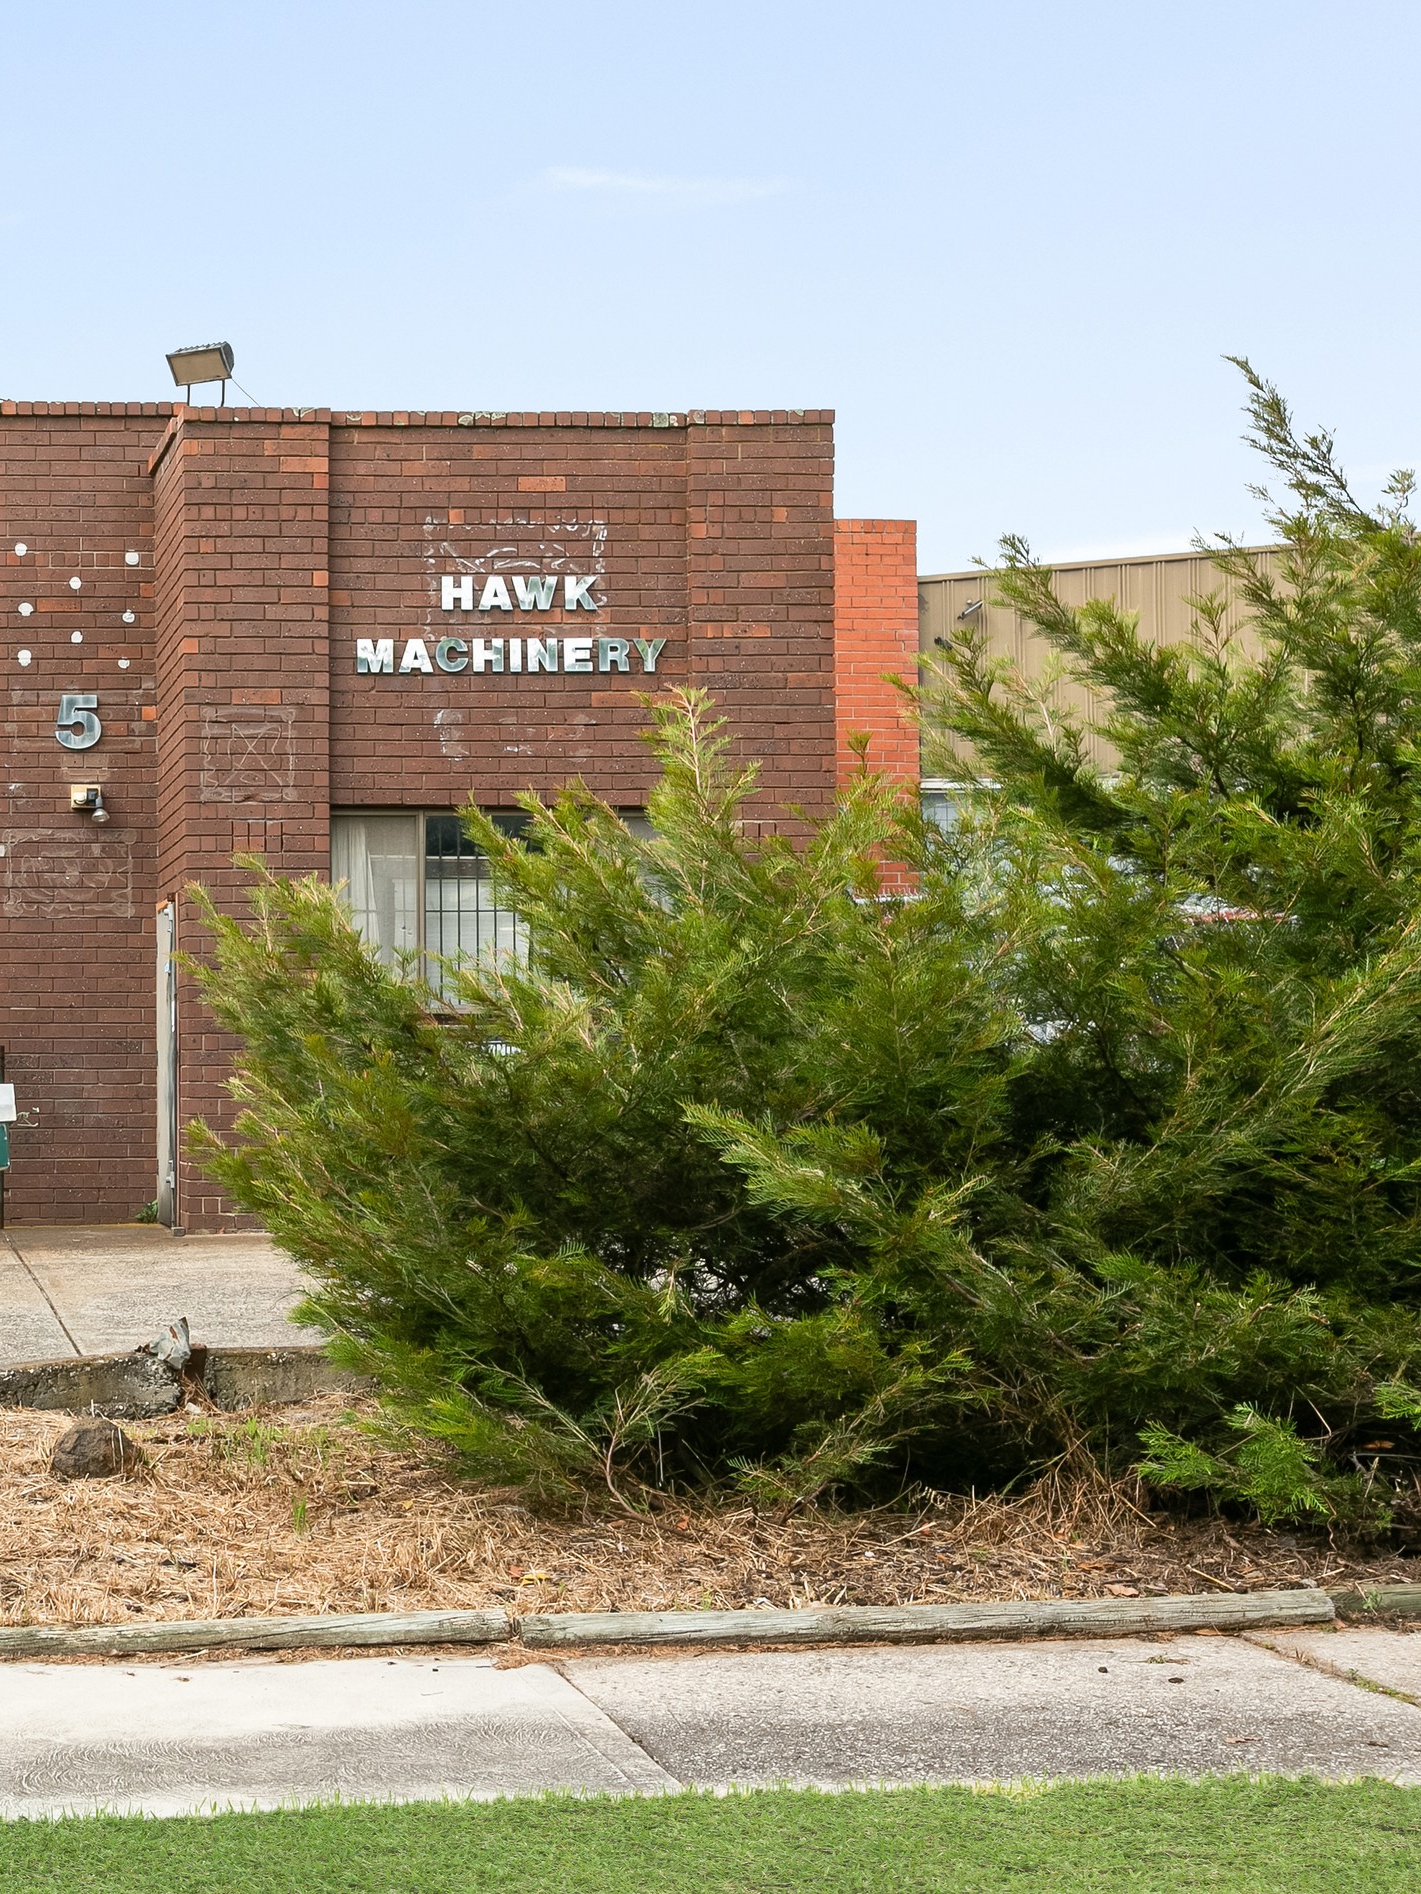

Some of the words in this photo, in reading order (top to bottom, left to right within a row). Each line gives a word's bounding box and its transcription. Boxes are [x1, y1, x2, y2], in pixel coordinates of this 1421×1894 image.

[441, 575, 598, 610] HAWK
[356, 638, 667, 673] MACHINERY
[55, 694, 102, 750] 5
